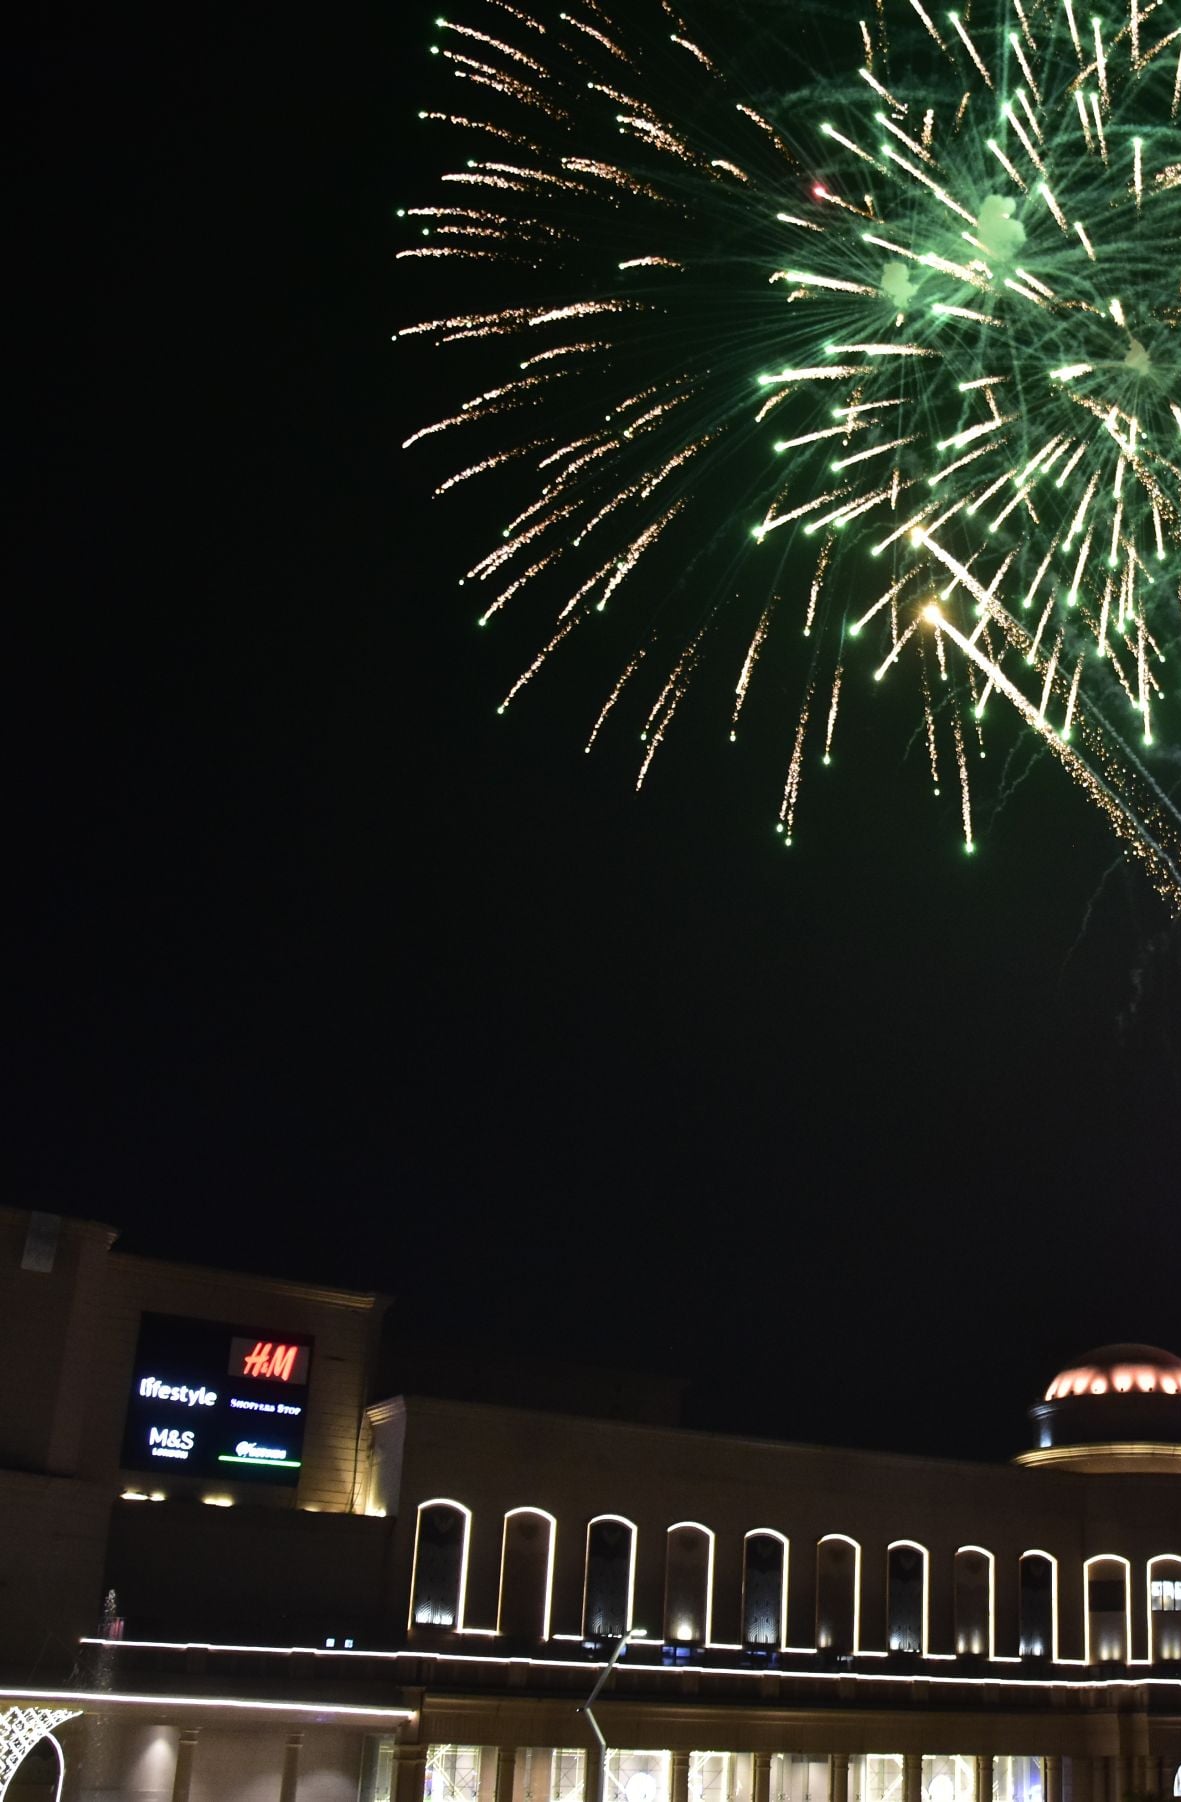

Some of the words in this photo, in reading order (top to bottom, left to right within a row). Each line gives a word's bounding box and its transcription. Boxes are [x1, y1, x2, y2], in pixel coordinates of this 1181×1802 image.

[243, 1342, 298, 1381] H&M
[139, 1376, 217, 1406] lifestyle
[149, 1426, 195, 1450] M&S
